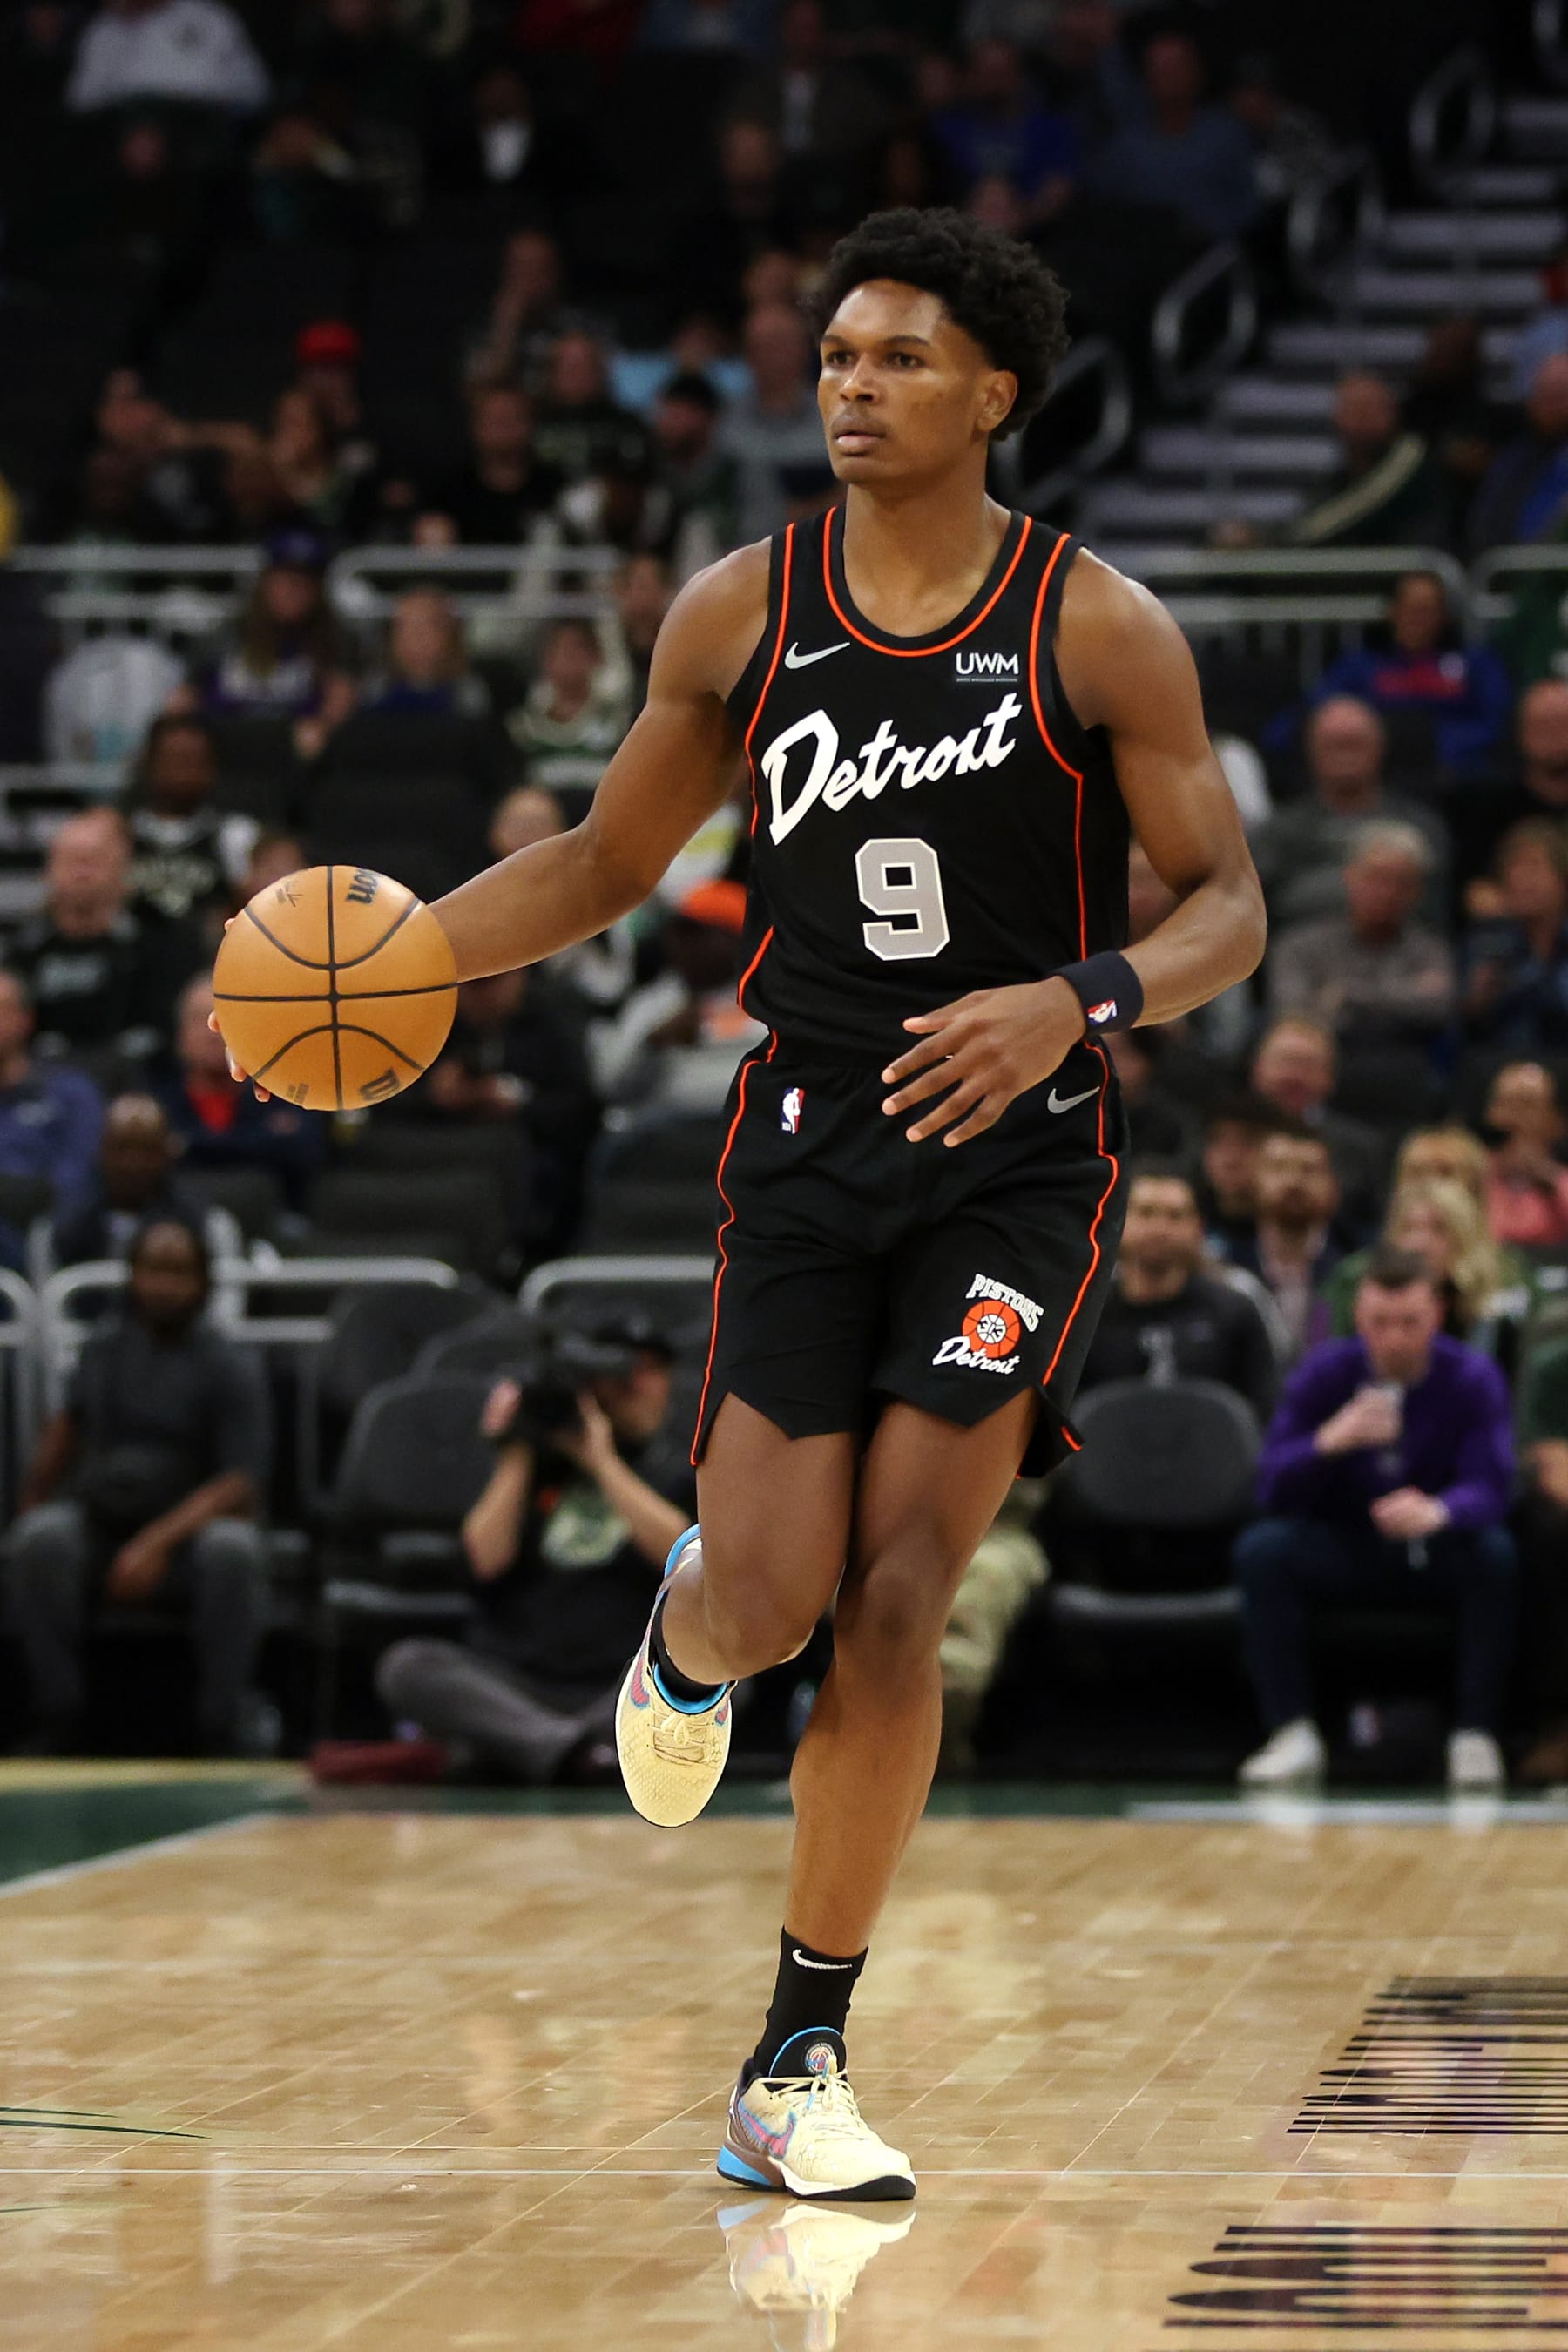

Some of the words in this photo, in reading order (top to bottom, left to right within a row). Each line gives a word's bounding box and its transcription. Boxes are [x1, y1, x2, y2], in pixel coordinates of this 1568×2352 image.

[956, 652, 1019, 675] UWM
[760, 693, 1023, 846] Detroit
[855, 838, 950, 962] 9
[965, 1273, 1044, 1333] PISTONS
[932, 1335, 1020, 1375] Detroit
